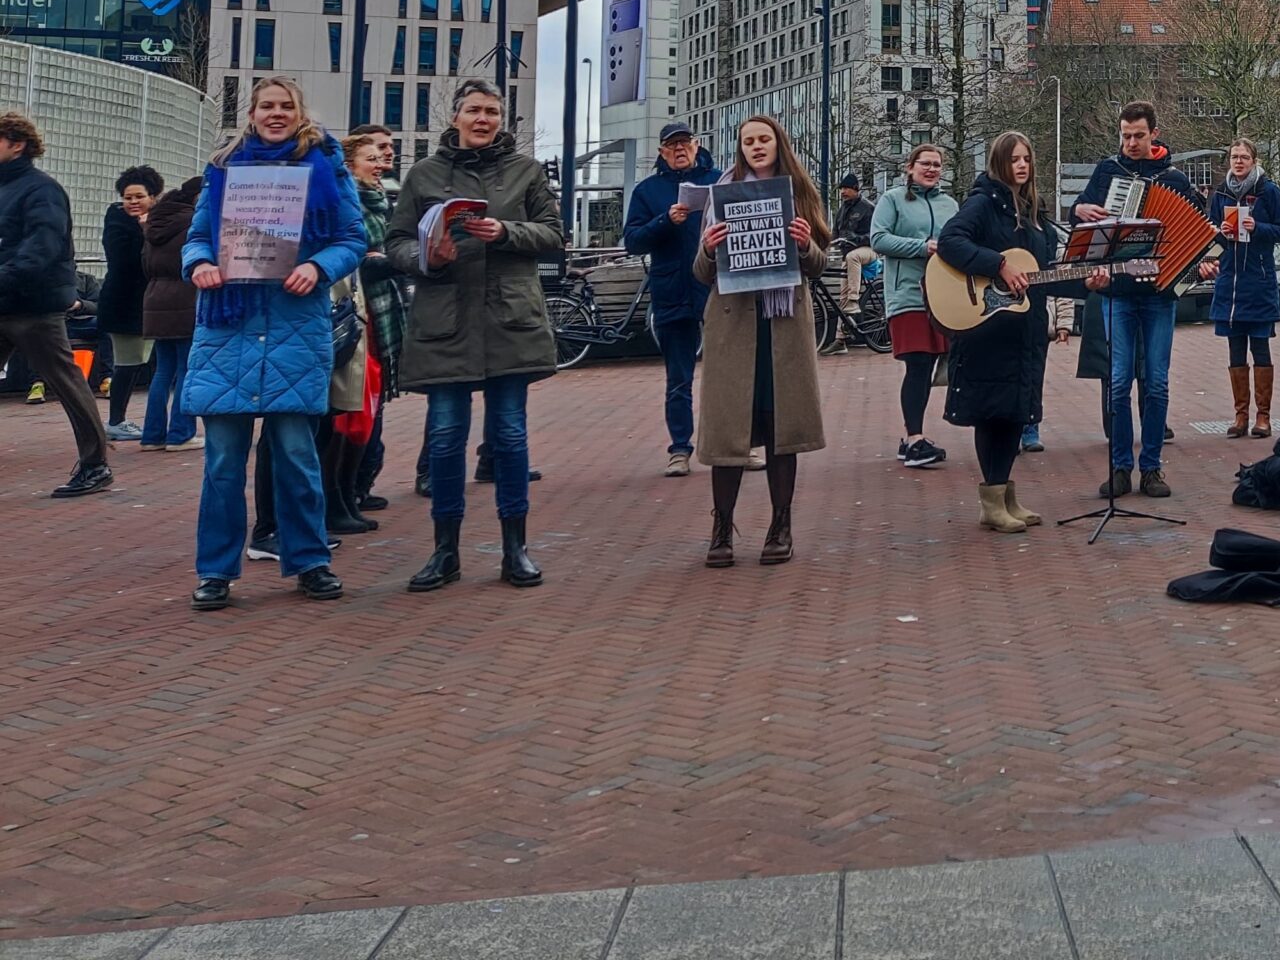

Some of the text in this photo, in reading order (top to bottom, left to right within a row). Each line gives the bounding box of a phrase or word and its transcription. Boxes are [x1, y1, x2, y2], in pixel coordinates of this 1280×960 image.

[229, 182, 254, 190] Come
[227, 194, 237, 202] all
[239, 195, 257, 203] you
[260, 194, 283, 202] who
[727, 200, 779, 216] JESUS IS THE
[233, 217, 284, 226] burdened,
[726, 216, 784, 233] ONLY WAY TO
[239, 229, 253, 237] He
[255, 228, 275, 237] will
[276, 230, 299, 239] give
[730, 231, 782, 251] HEAVEN
[729, 249, 787, 269] JOHN 14:6
